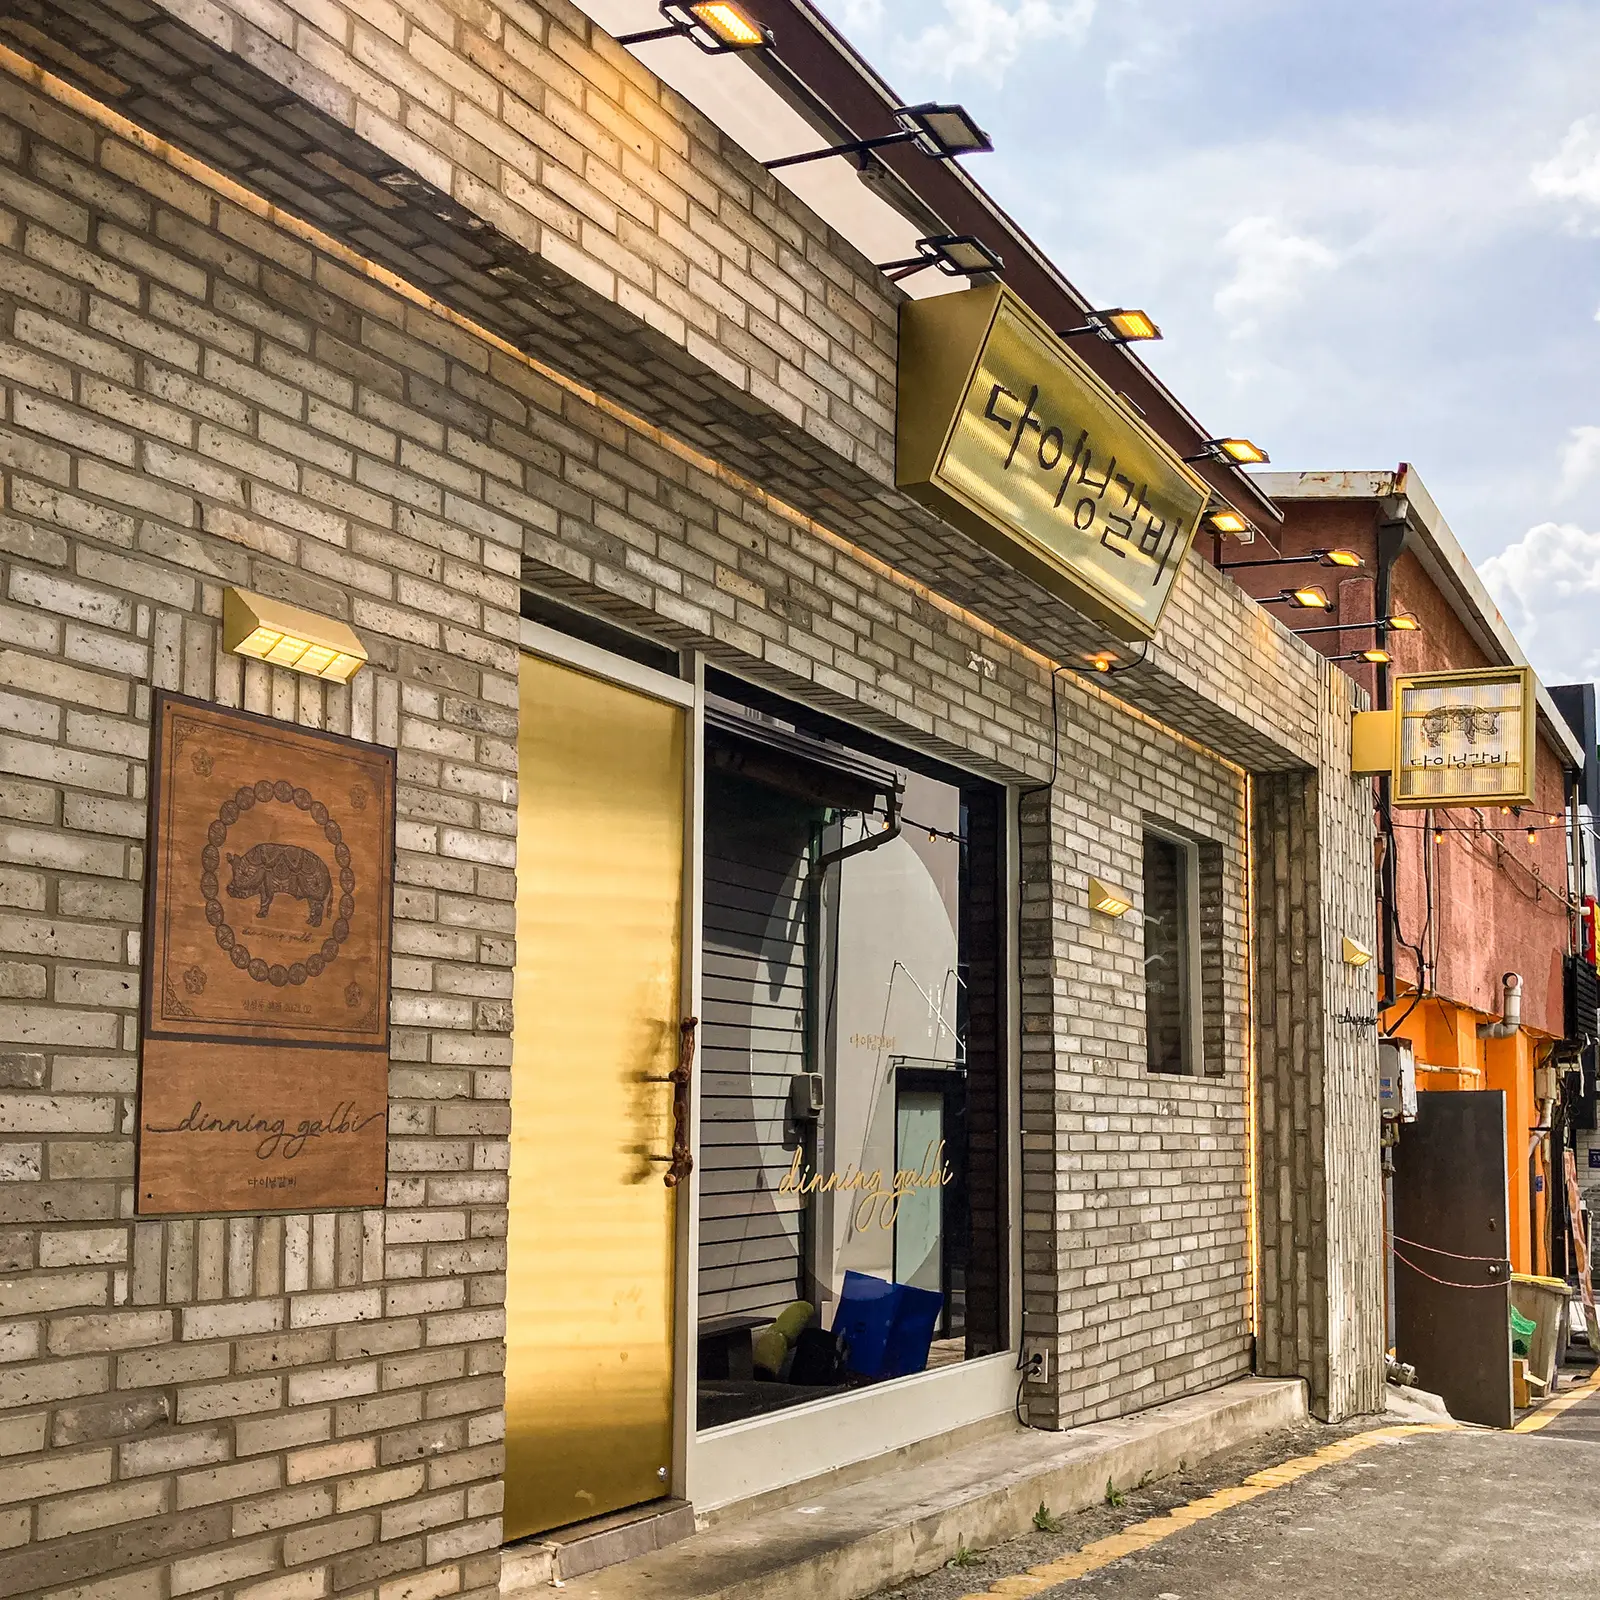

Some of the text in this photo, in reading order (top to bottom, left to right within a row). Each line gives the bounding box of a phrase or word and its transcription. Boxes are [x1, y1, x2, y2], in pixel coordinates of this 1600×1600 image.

[985, 385, 1183, 586] 다이닝갈비
[1410, 751, 1508, 770] 다이닝갈비
[146, 1101, 384, 1160] dinning galbi
[247, 1176, 297, 1189] 다이닝갈비
[779, 1139, 954, 1233] dinning galbi
